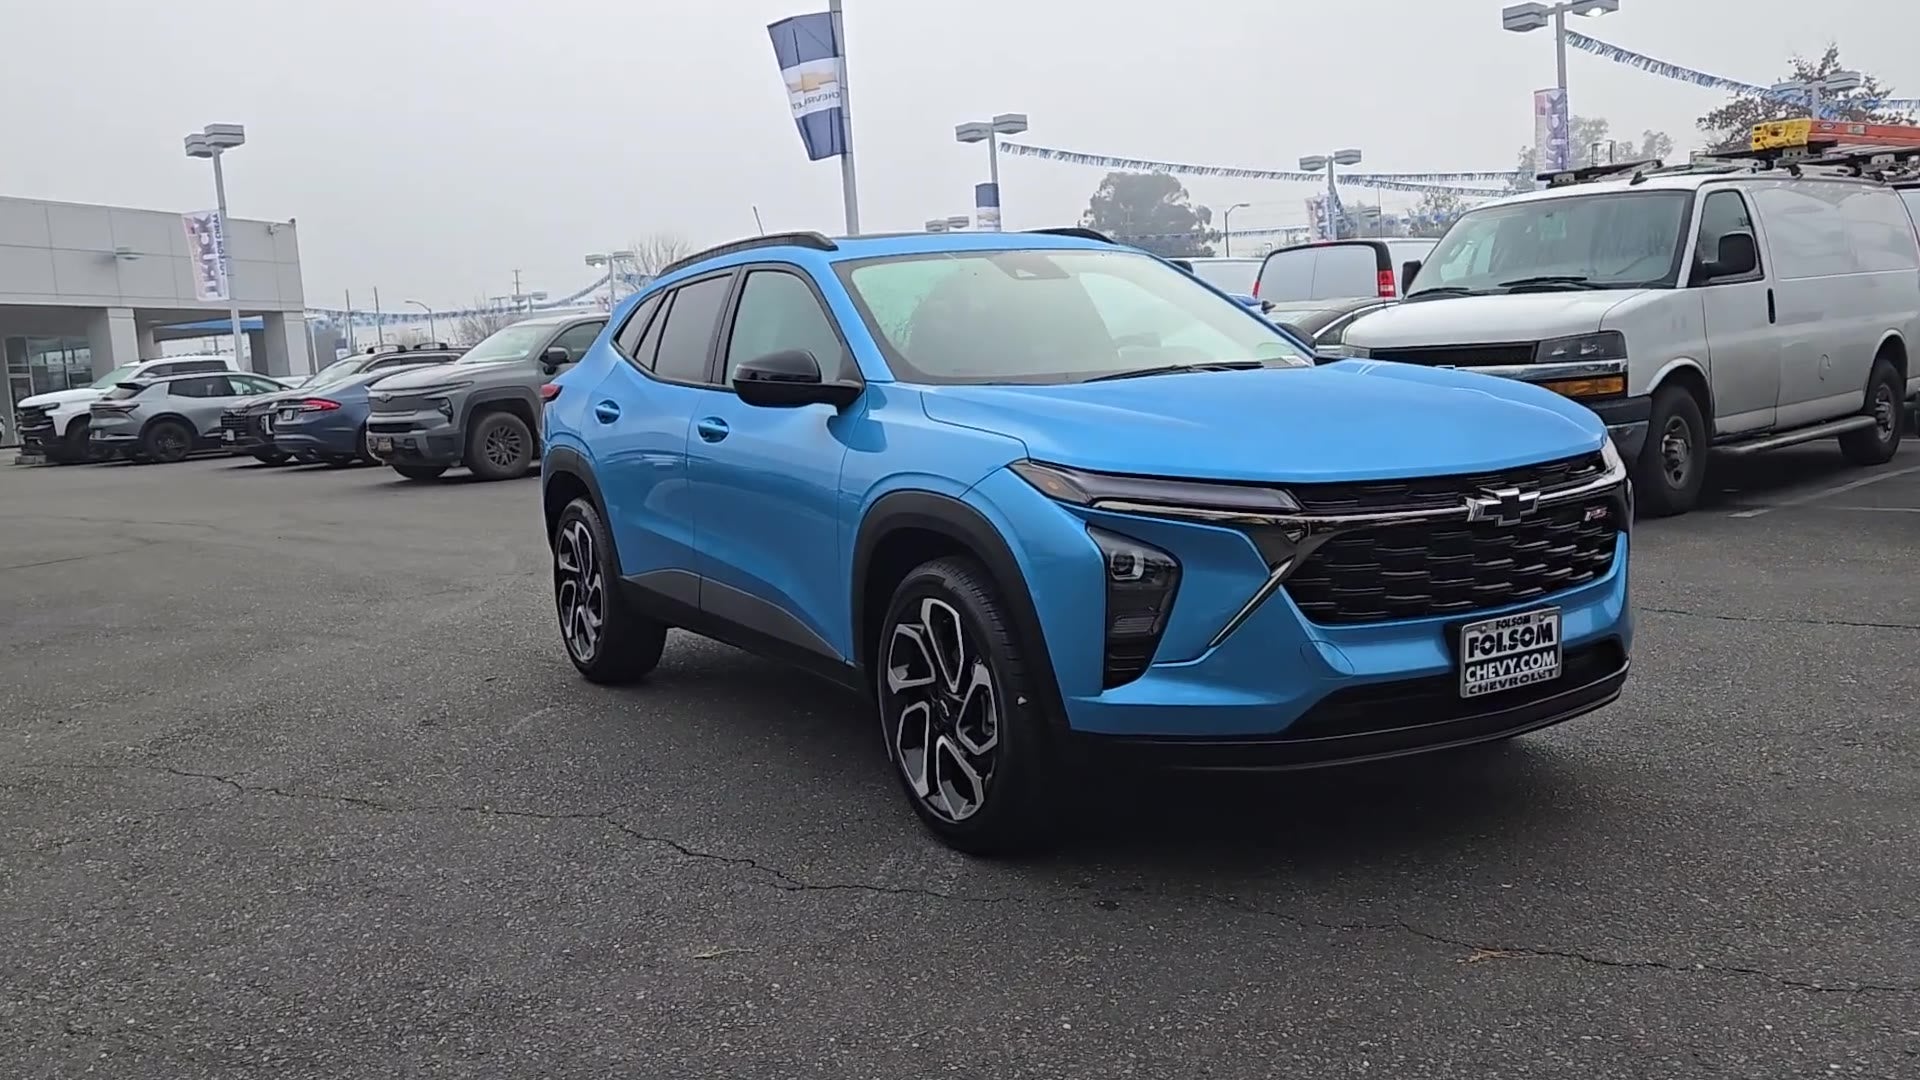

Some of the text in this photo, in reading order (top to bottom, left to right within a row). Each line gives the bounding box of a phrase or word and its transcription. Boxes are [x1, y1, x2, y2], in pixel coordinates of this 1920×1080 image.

[1496, 615, 1531, 630] FOLSOM
[1468, 622, 1554, 658] FOLSOM
[1466, 650, 1555, 682] CHEVY.COM
[1468, 669, 1555, 694] CHEVROLET
